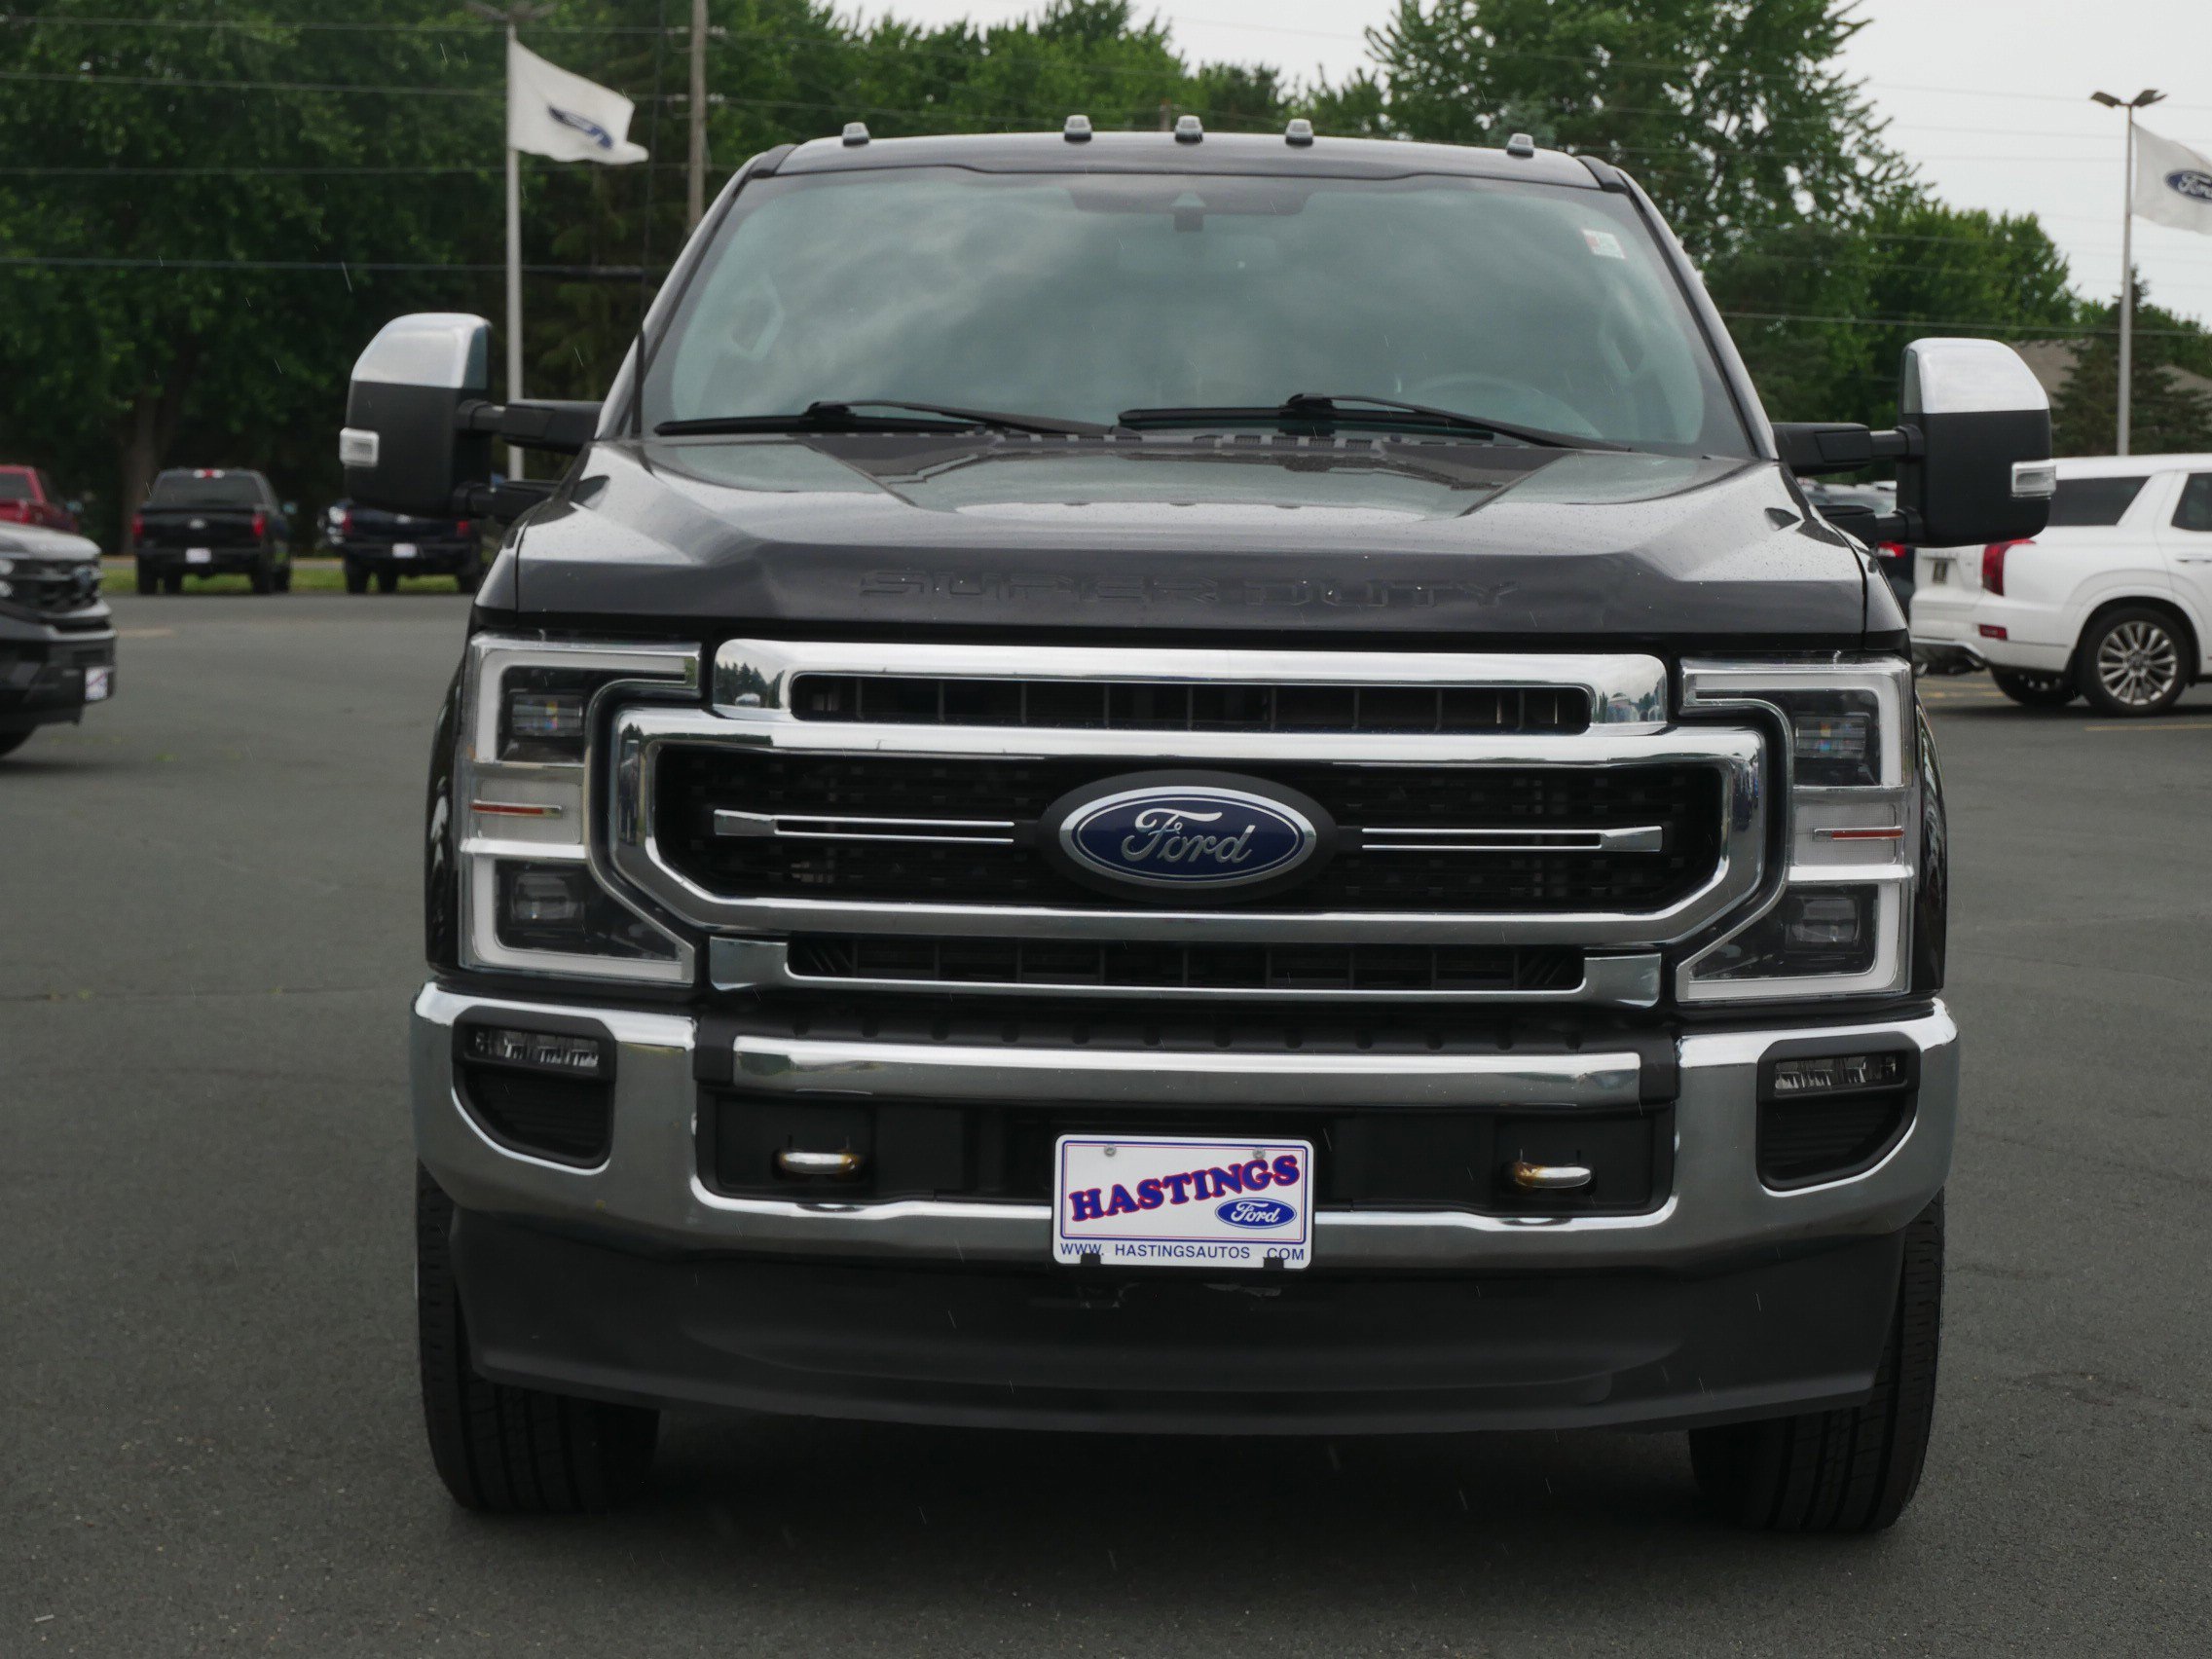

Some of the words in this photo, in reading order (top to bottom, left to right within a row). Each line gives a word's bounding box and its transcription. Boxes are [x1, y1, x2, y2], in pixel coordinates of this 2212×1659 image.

[861, 570, 1219, 605] SUPER
[1244, 577, 1520, 608] DUTY
[1122, 807, 1256, 864] Ford
[1068, 1155, 1300, 1222] HASTINGS
[1231, 1200, 1279, 1223] Ford
[1115, 1245, 1250, 1259] HASTINGSAUTOS
